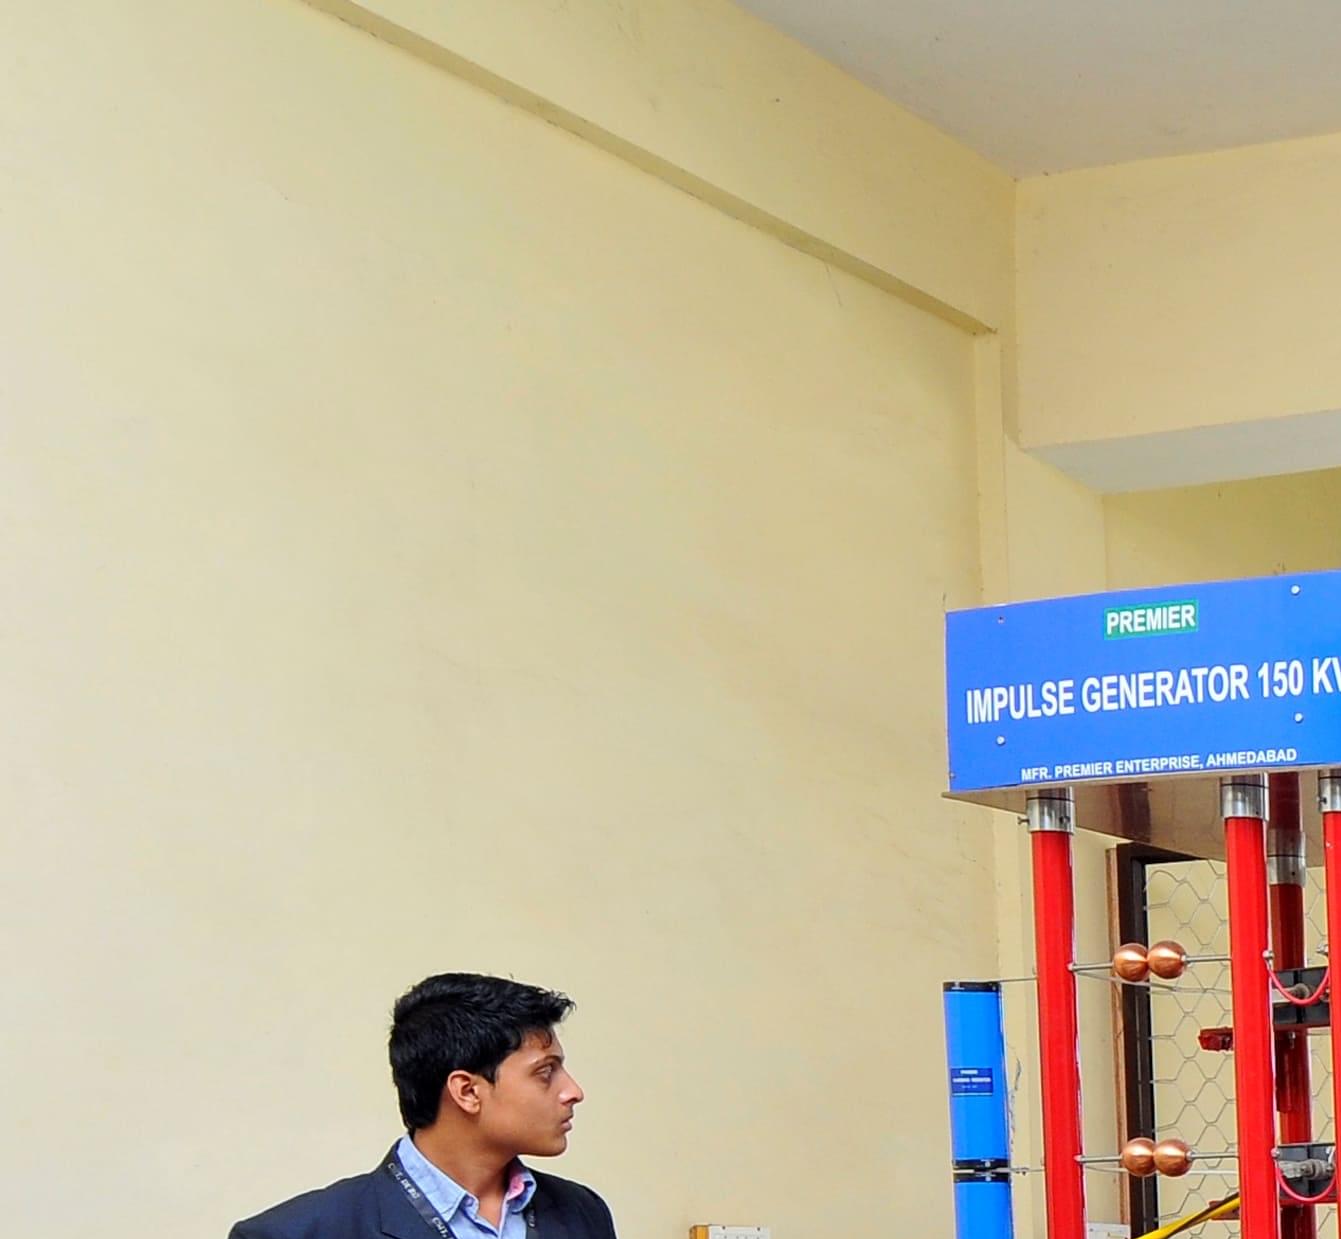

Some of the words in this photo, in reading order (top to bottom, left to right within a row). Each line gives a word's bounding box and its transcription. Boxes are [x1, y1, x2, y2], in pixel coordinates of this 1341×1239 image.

[1107, 604, 1197, 635] PREMIER
[966, 680, 1076, 724] IMPULSE
[1081, 664, 1248, 713] GENERATOR
[1258, 660, 1302, 699] 150
[1021, 765, 1052, 782] MFR.
[1055, 761, 1113, 780] PREMIER
[1115, 754, 1203, 775] ENTERPRISE,
[1206, 748, 1297, 767] AHMEDABAD
